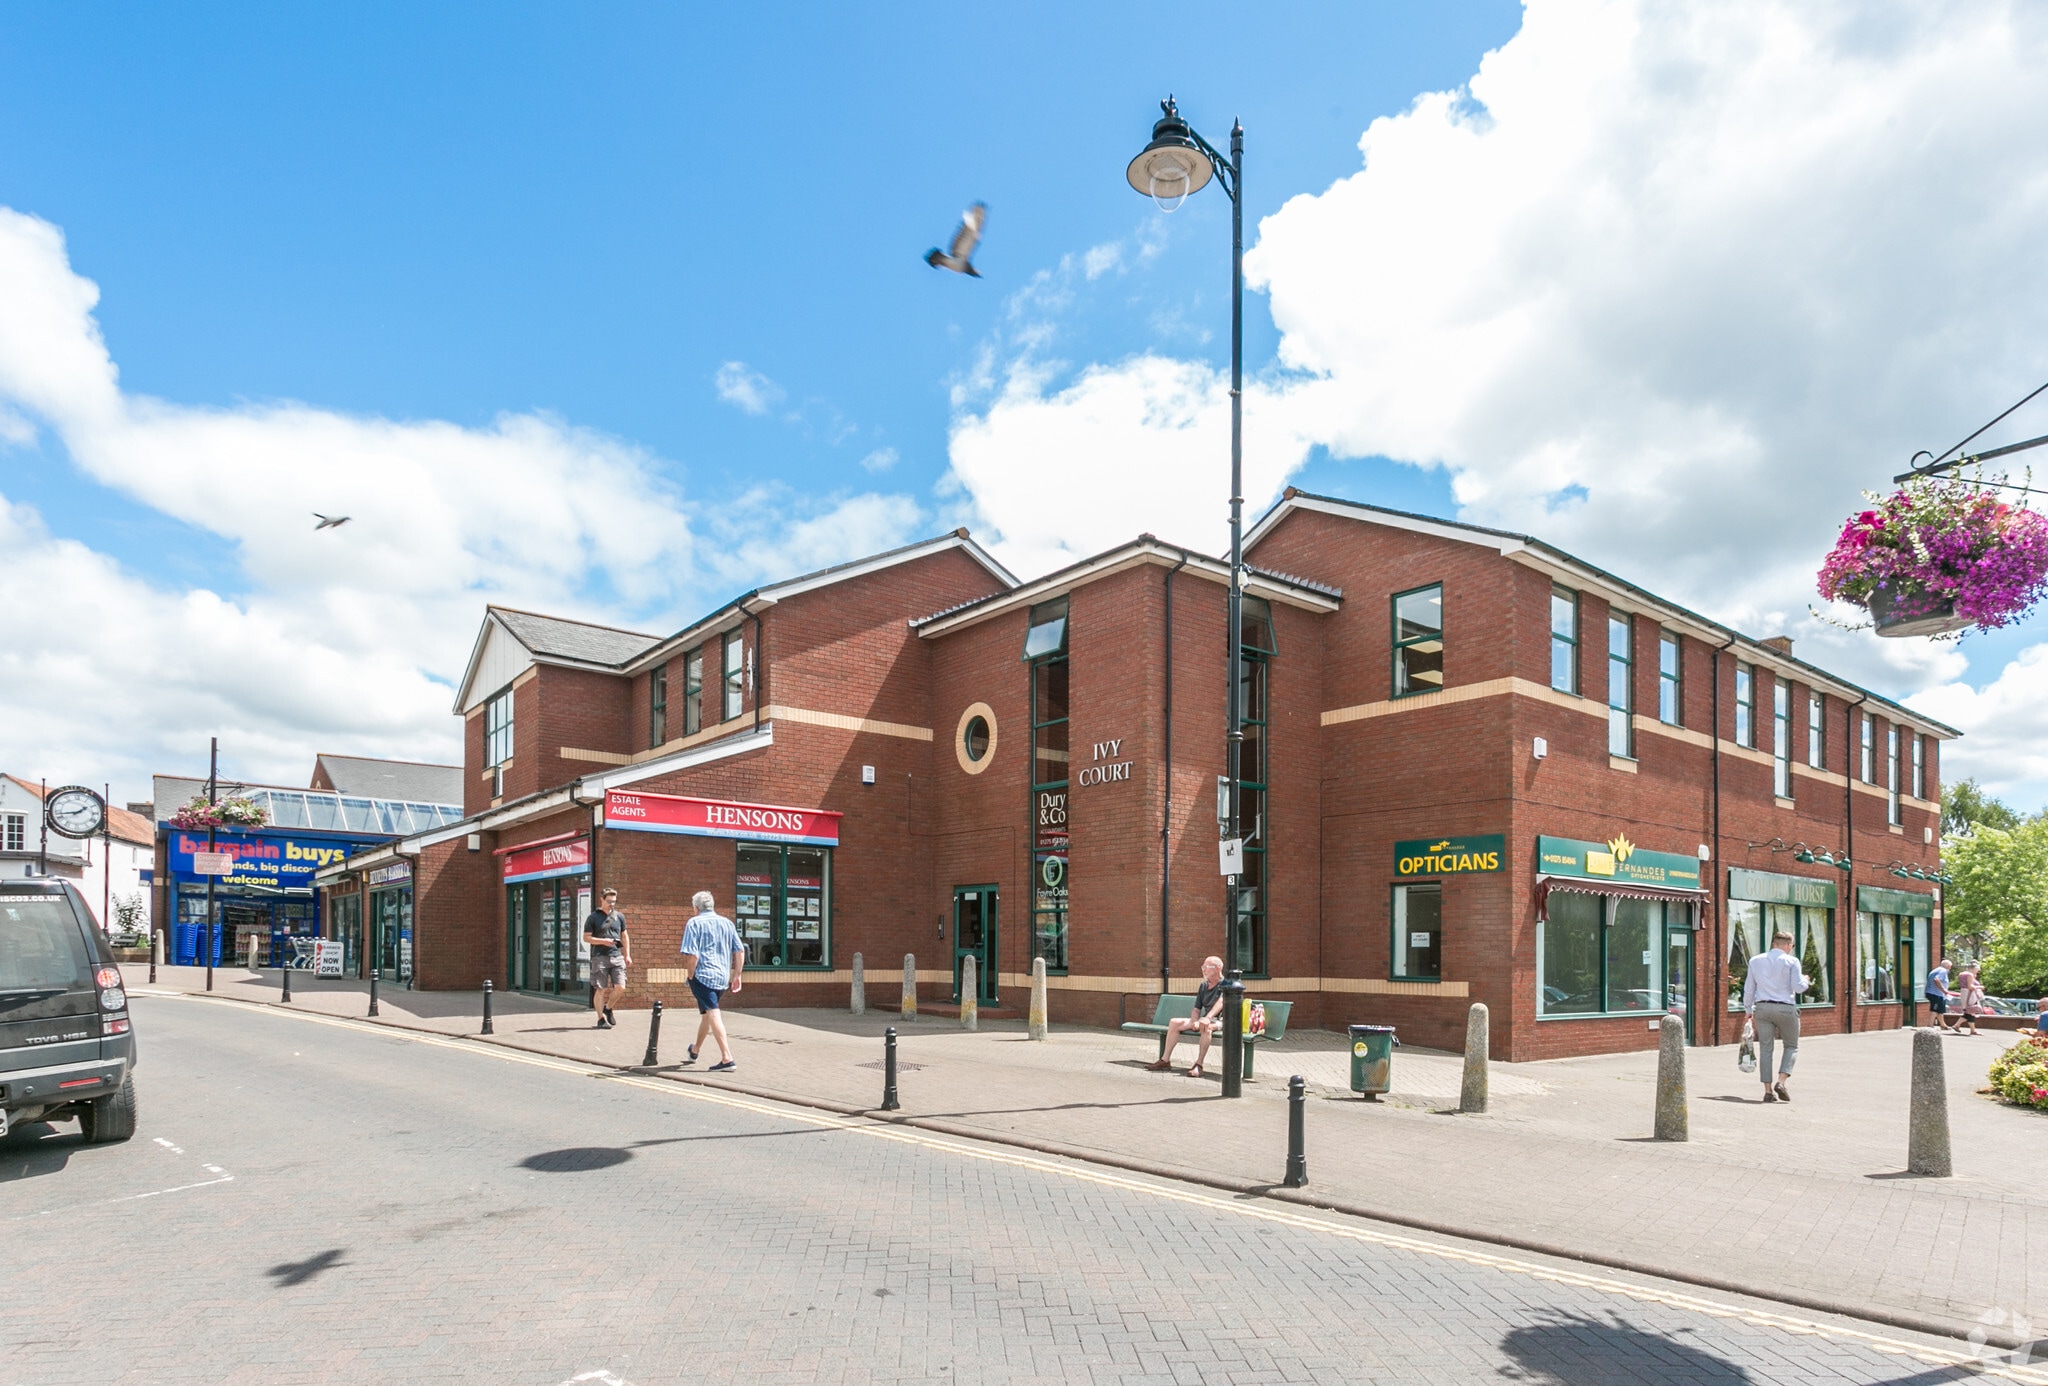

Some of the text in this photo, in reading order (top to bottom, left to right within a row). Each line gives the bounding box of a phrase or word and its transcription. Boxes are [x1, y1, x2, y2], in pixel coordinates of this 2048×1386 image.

[1093, 739, 1122, 760] IVY
[1079, 761, 1133, 786] COURT
[611, 794, 641, 806] ESTATE
[1040, 793, 1066, 810] Dury
[611, 805, 646, 817] AGENTS
[706, 805, 803, 831] HENSONS
[179, 835, 345, 866] bargain buys
[542, 845, 572, 866] HENSONS
[231, 862, 258, 872] ands,
[260, 861, 277, 874] big
[1399, 852, 1499, 874] OPTICIANS
[1614, 862, 1665, 876] FERNANDES
[222, 875, 279, 886] welcome
[737, 874, 760, 883] ENSONS
[787, 877, 809, 885] ENSONS
[1228, 875, 1234, 884] 3
[1745, 877, 1826, 903] GOLDEN HORSE
[25, 1031, 88, 1045] TDV6 HSE
